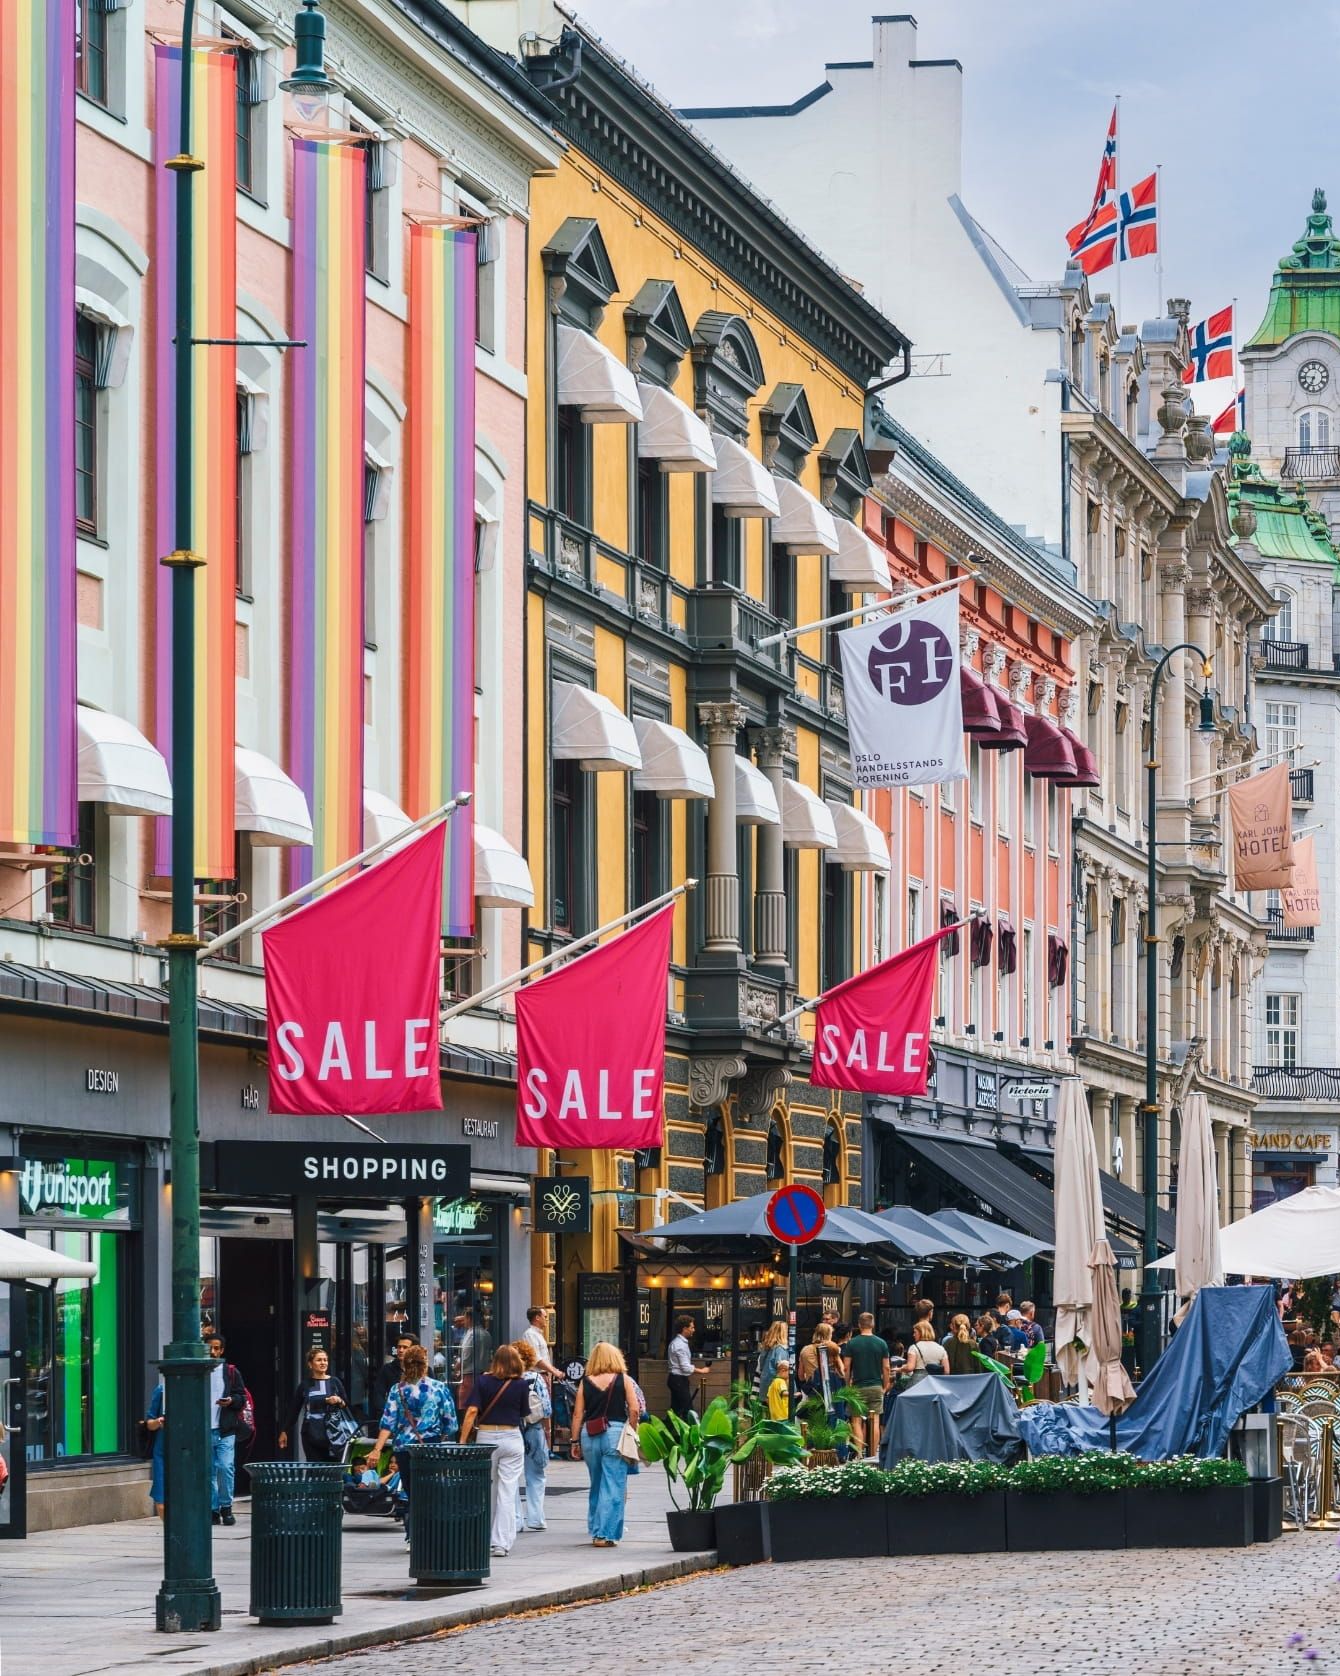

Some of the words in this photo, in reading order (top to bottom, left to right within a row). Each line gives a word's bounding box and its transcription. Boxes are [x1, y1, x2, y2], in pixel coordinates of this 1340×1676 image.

[855, 753, 881, 763] OSLO
[856, 758, 944, 773] HANDELSSTANDS
[857, 772, 909, 784] FORENING
[1237, 829, 1257, 839] KARL
[1239, 837, 1289, 857] HOTEL
[1286, 898, 1321, 912] HOTEL
[276, 1018, 430, 1081] SALE
[820, 1024, 924, 1073] SALE
[87, 1068, 119, 1093] DESIGN
[1008, 1086, 1050, 1095] Victoria
[243, 1084, 259, 1109] HÅR
[524, 1067, 656, 1120] SALE
[463, 1118, 499, 1139] RESTAURANT
[303, 1156, 448, 1181] SHOPPING
[583, 1284, 620, 1295] EGON
